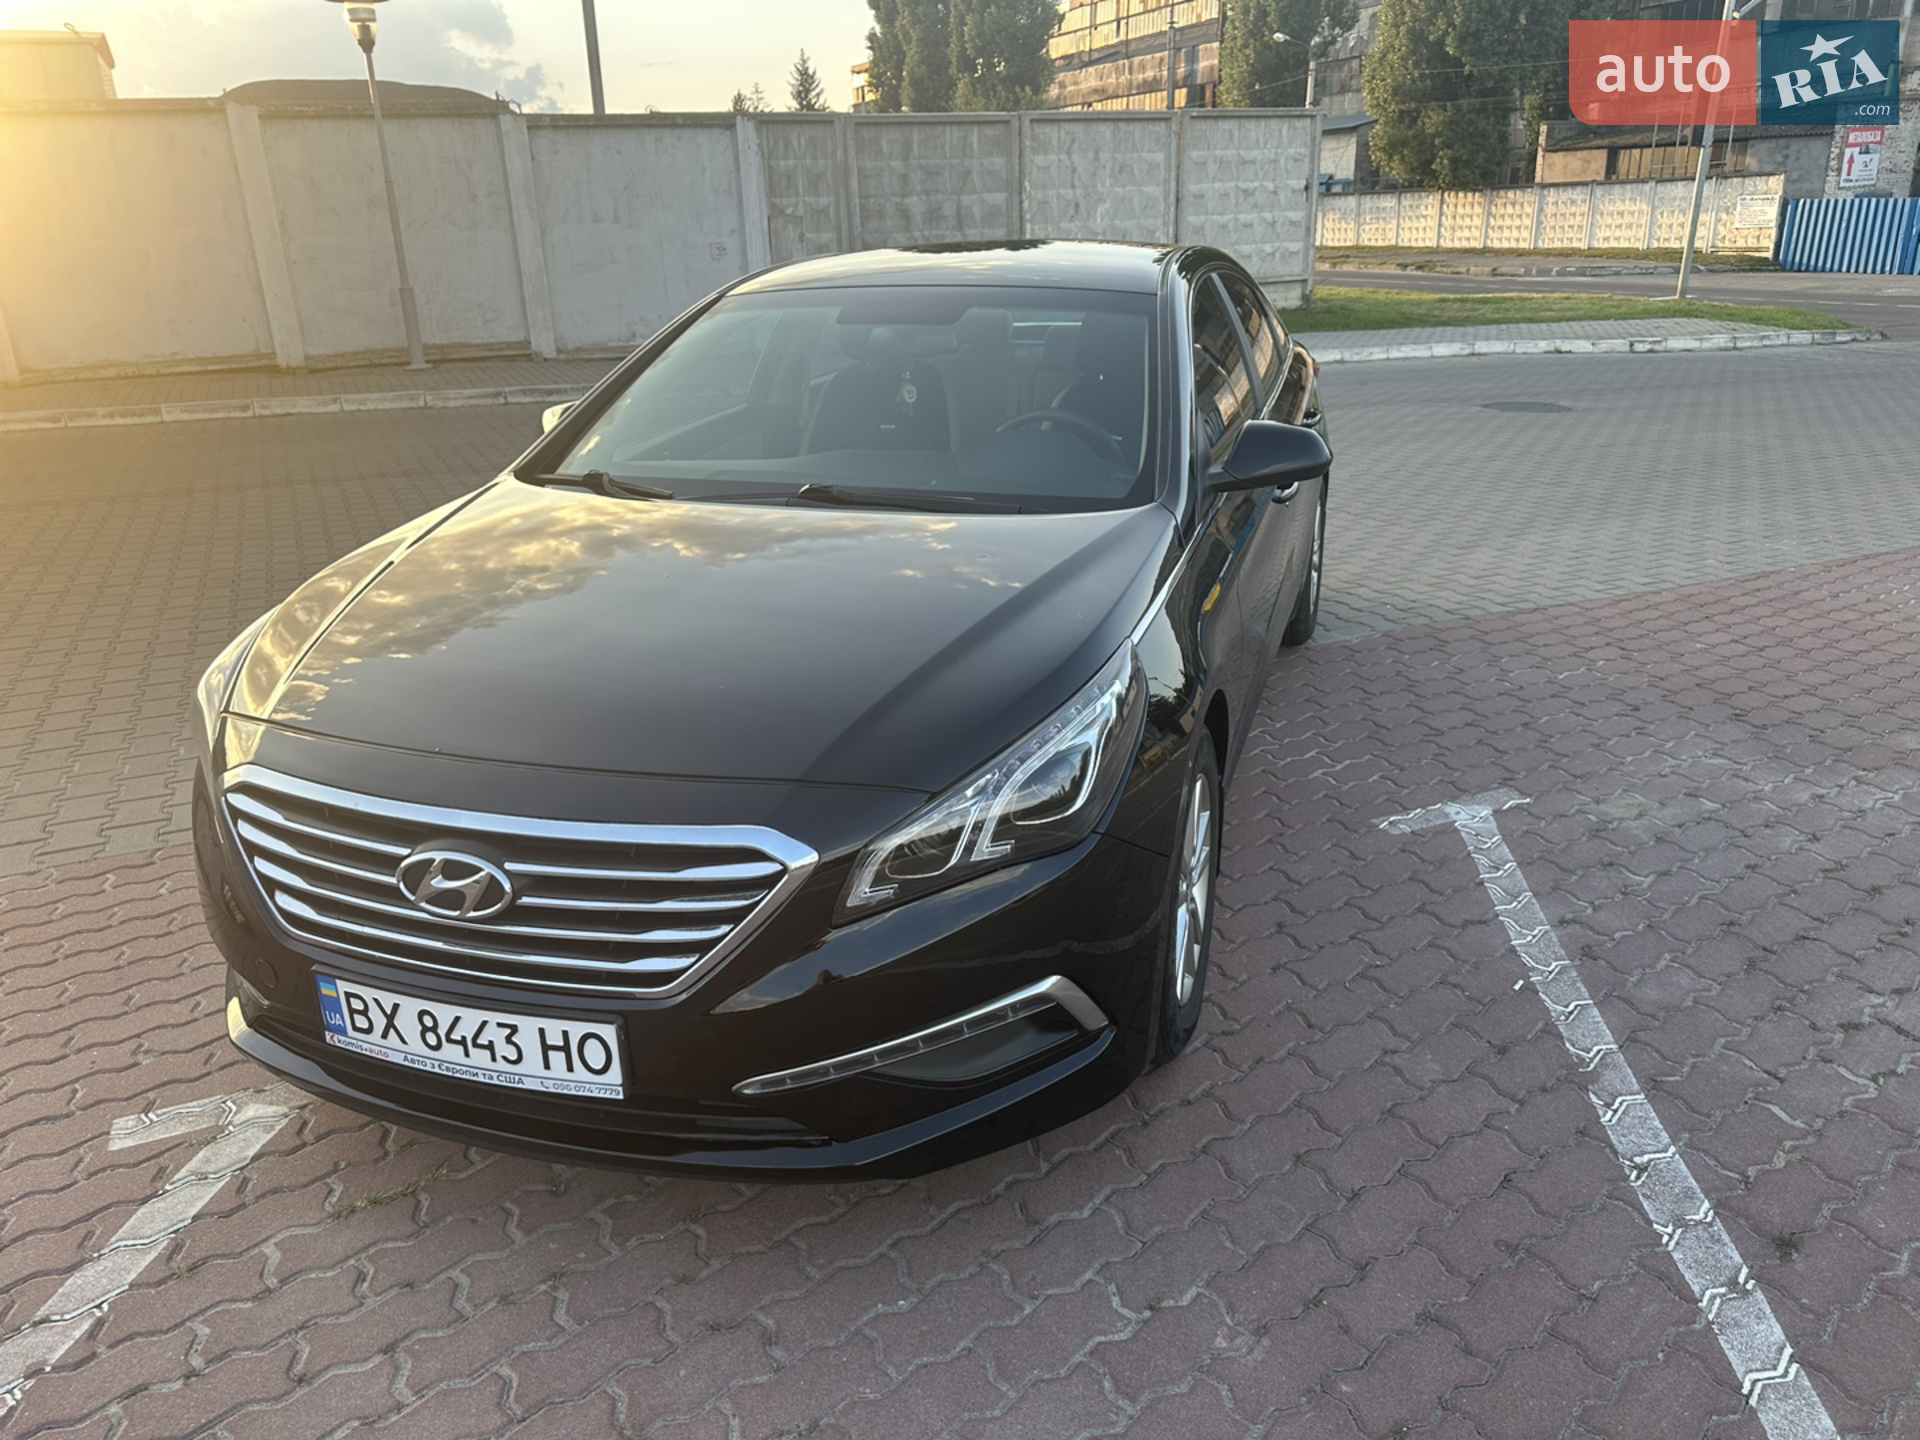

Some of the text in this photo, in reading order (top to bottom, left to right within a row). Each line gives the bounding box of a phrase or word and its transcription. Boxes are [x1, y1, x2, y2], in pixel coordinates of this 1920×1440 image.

[326, 1009, 345, 1028] UA
[343, 990, 408, 1045] BX
[417, 1008, 524, 1066] 8443
[402, 1054, 428, 1068] Авто
[437, 1062, 479, 1080] Європи
[481, 1071, 494, 1082] та
[496, 1073, 526, 1086] США
